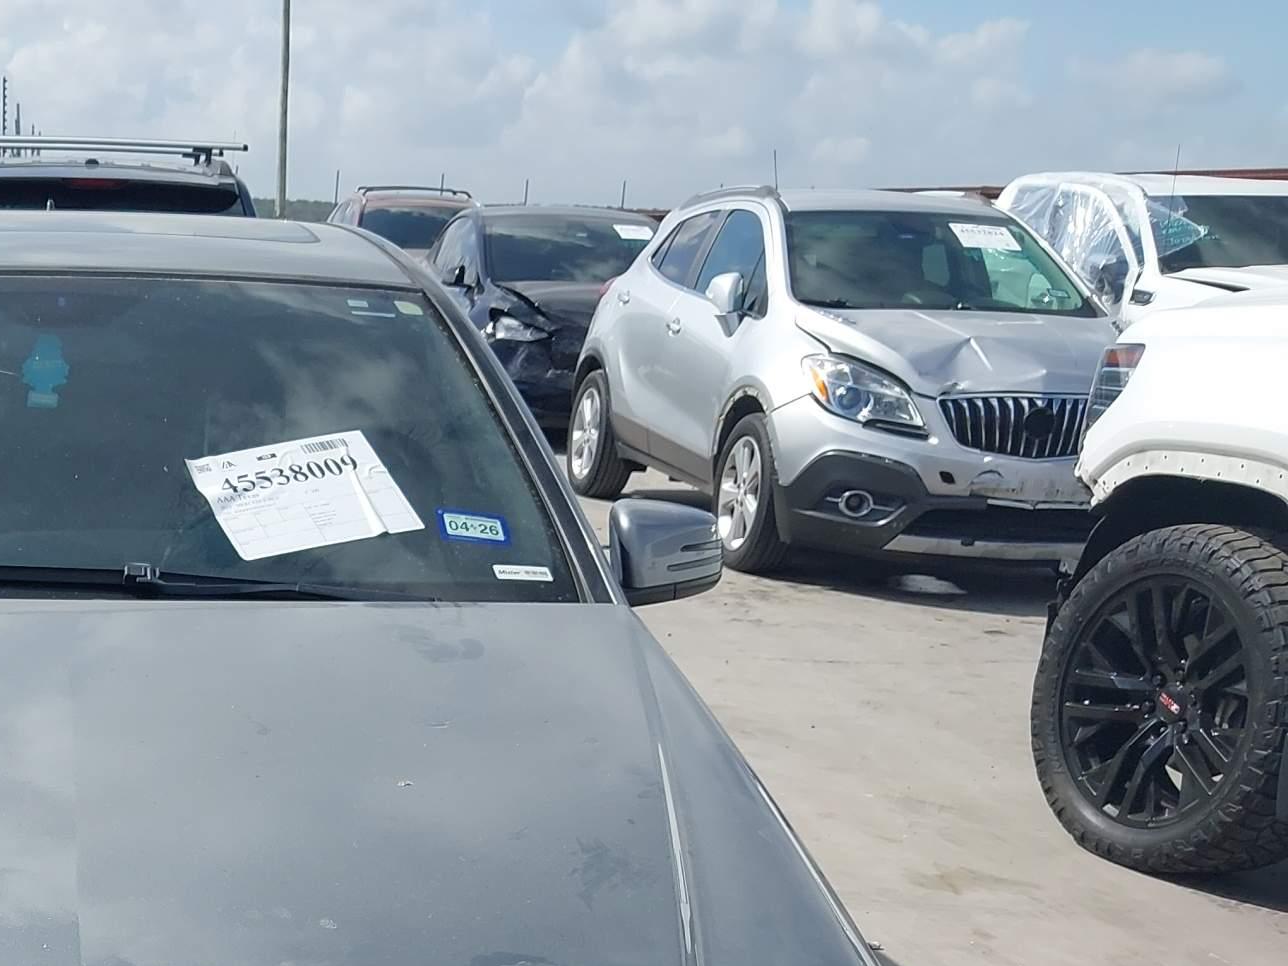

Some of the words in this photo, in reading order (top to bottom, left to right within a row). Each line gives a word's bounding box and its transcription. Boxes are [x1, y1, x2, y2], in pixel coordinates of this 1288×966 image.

[221, 455, 357, 494] 45538009
[448, 520, 470, 532] 04
[478, 523, 499, 536] 26
